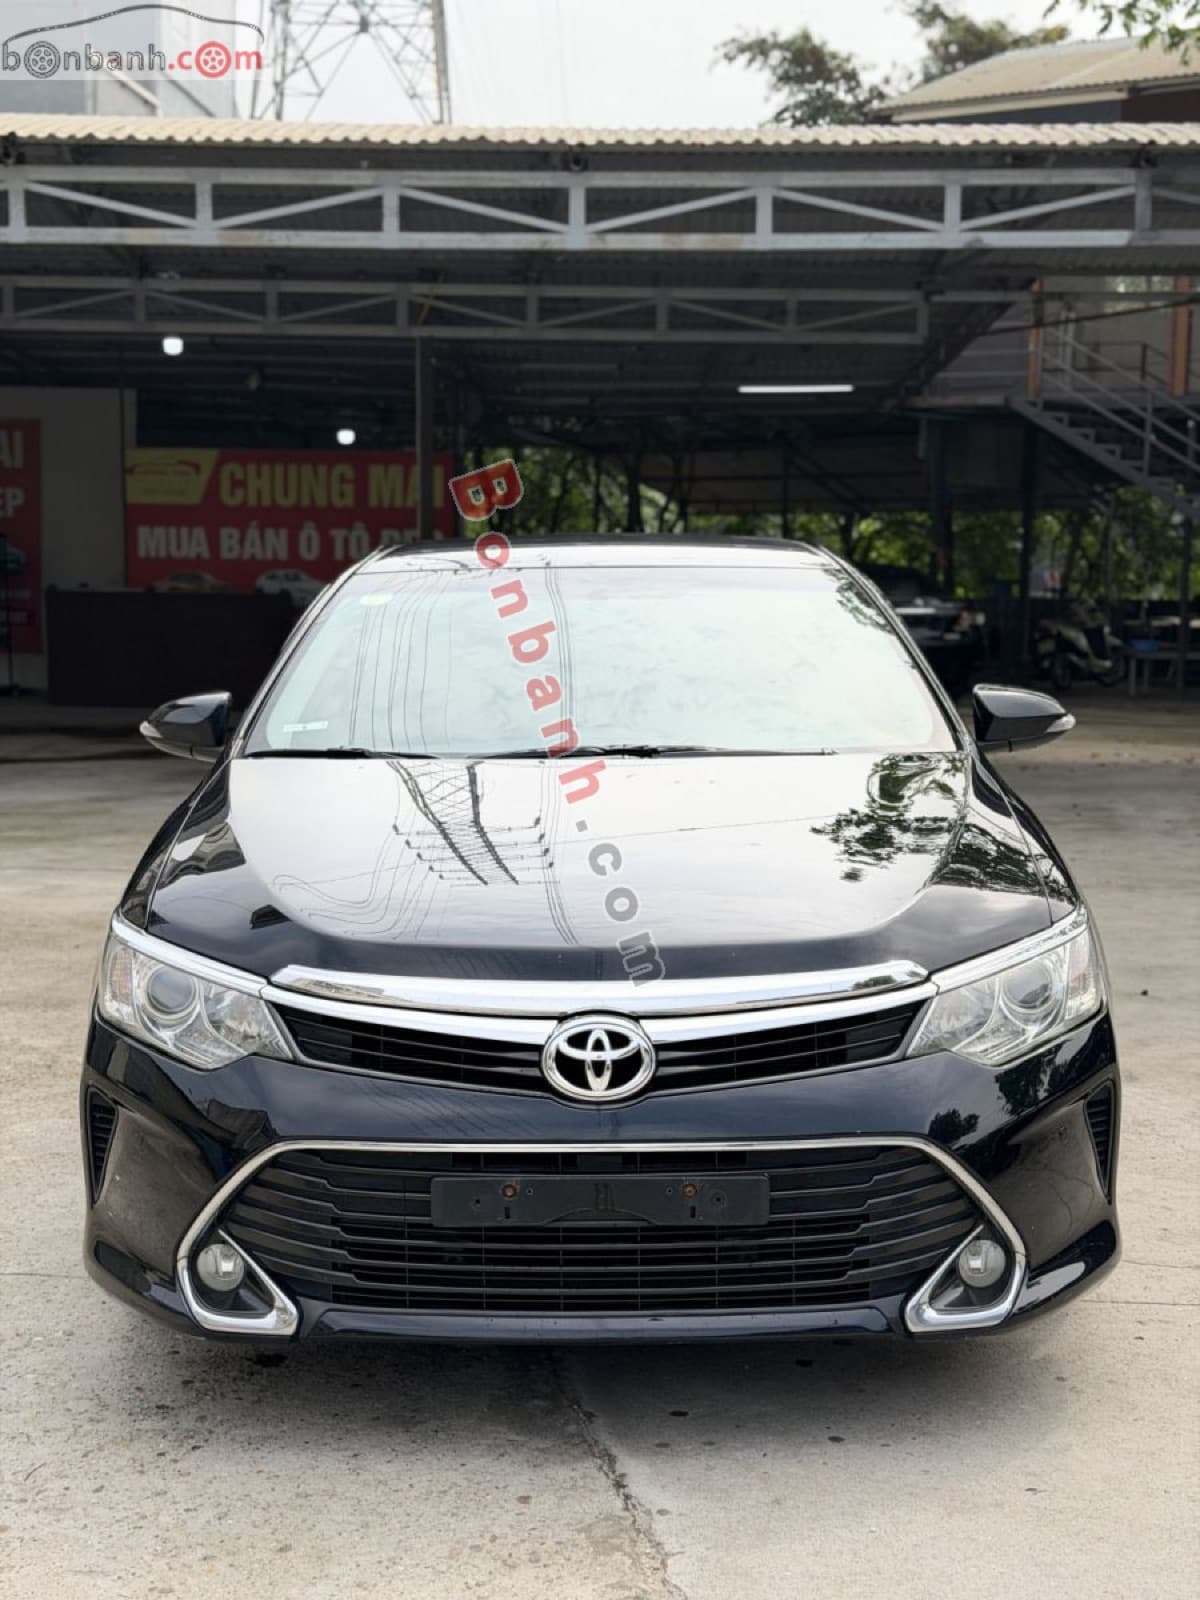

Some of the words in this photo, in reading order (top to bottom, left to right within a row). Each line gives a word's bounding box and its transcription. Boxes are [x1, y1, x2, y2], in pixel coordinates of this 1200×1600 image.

[219, 462, 356, 509] CHUNG
[137, 525, 210, 560] MUA
[219, 519, 289, 561] BÁN
[299, 519, 321, 561] Ô
[329, 520, 370, 561] TÔ
